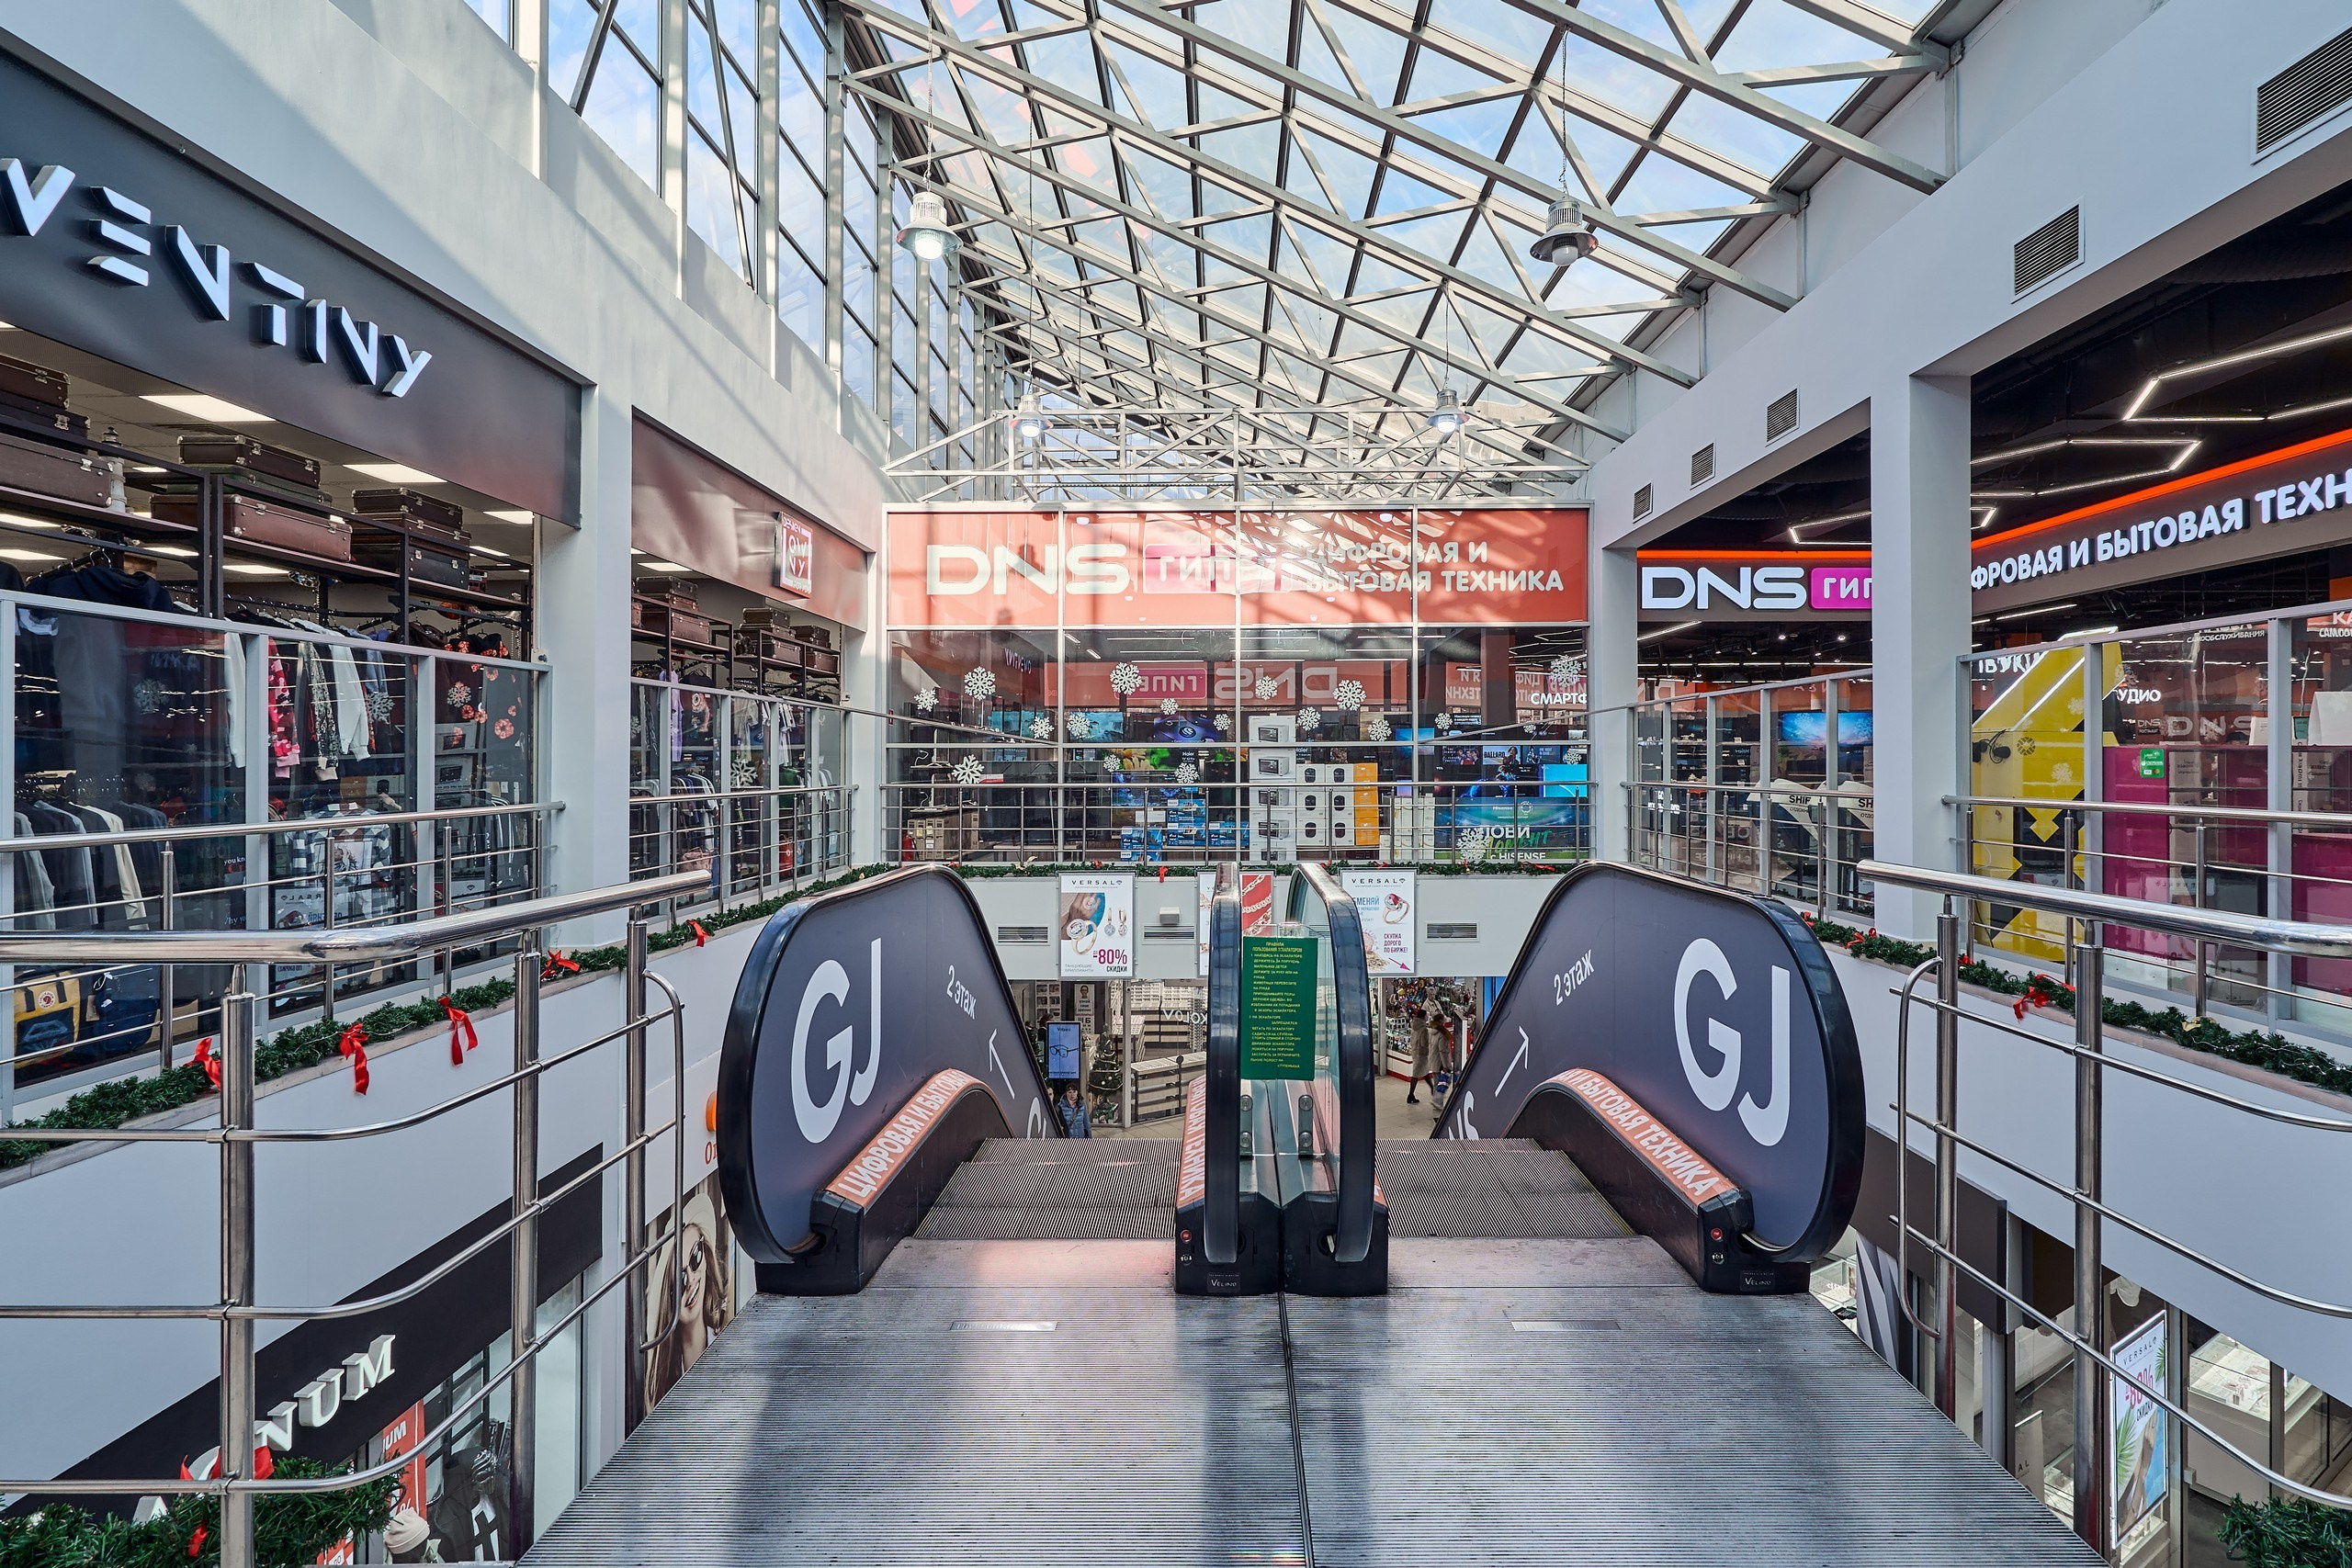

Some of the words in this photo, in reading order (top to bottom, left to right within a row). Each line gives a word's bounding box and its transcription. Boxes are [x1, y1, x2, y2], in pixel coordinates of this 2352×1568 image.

[1468, 541, 1488, 563] И
[2070, 537, 2089, 569] И
[2097, 497, 2244, 563] БЫТОВАЯ
[926, 543, 1130, 595] DNS
[1441, 570, 1565, 592] ТЕХНИКА
[1641, 566, 1807, 610] DNS
[945, 964, 956, 997] 2
[955, 978, 977, 1021] этаж
[1554, 973, 1564, 1006] 2
[1563, 949, 1595, 997] этаж
[791, 937, 882, 1145] GJ
[1673, 938, 1791, 1147] GJ
[837, 1114, 925, 1198] ЦИФРОВАЯ
[906, 1106, 930, 1122] И
[1577, 1074, 1645, 1132] БЫТОВАЯ
[1634, 1123, 1721, 1197] ТЕХНИКА
[2123, 1340, 2153, 1366] VERSAL
